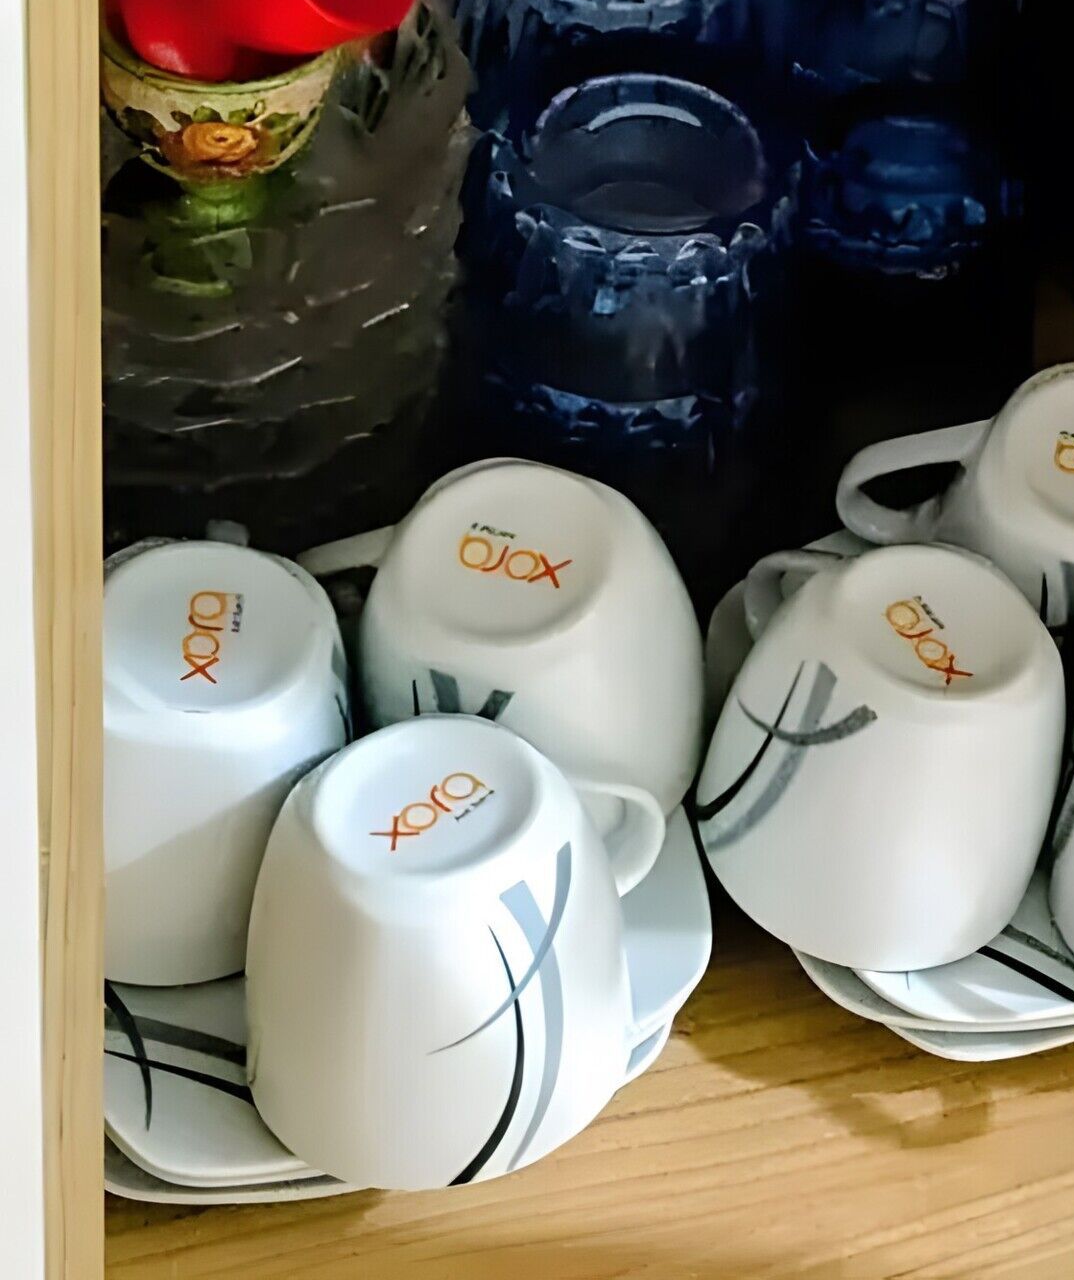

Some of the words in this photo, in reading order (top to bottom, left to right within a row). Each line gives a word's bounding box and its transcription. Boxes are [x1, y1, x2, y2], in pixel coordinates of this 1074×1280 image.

[458, 534, 573, 589] xora
[180, 591, 232, 684] xora
[884, 598, 973, 686] xora
[369, 772, 487, 851] xora
